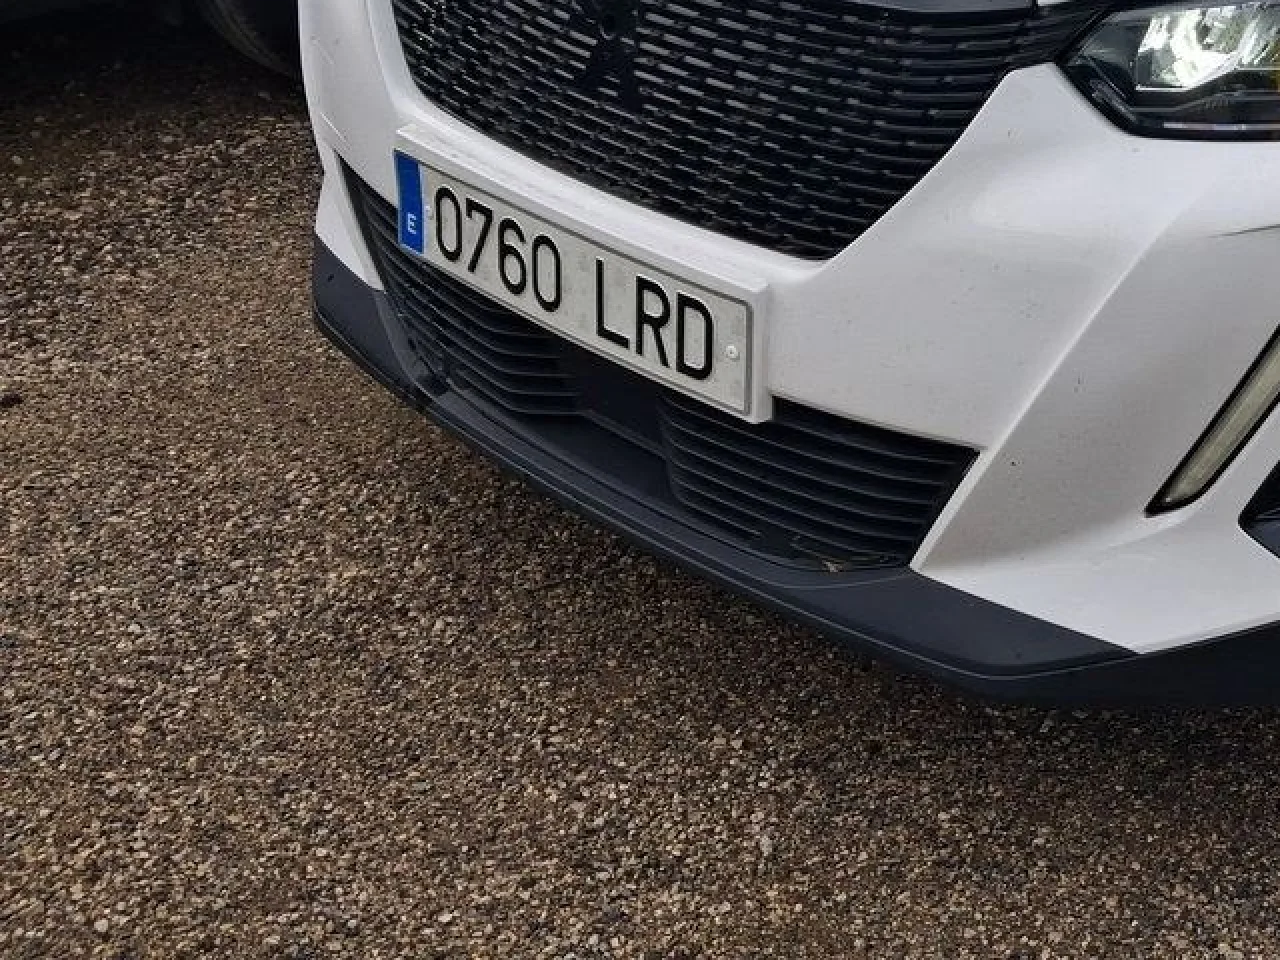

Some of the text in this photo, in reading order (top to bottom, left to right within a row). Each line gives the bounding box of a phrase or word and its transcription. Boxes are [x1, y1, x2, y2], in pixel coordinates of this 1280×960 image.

[406, 213, 417, 235] E
[434, 186, 714, 381] 0760 LRD
